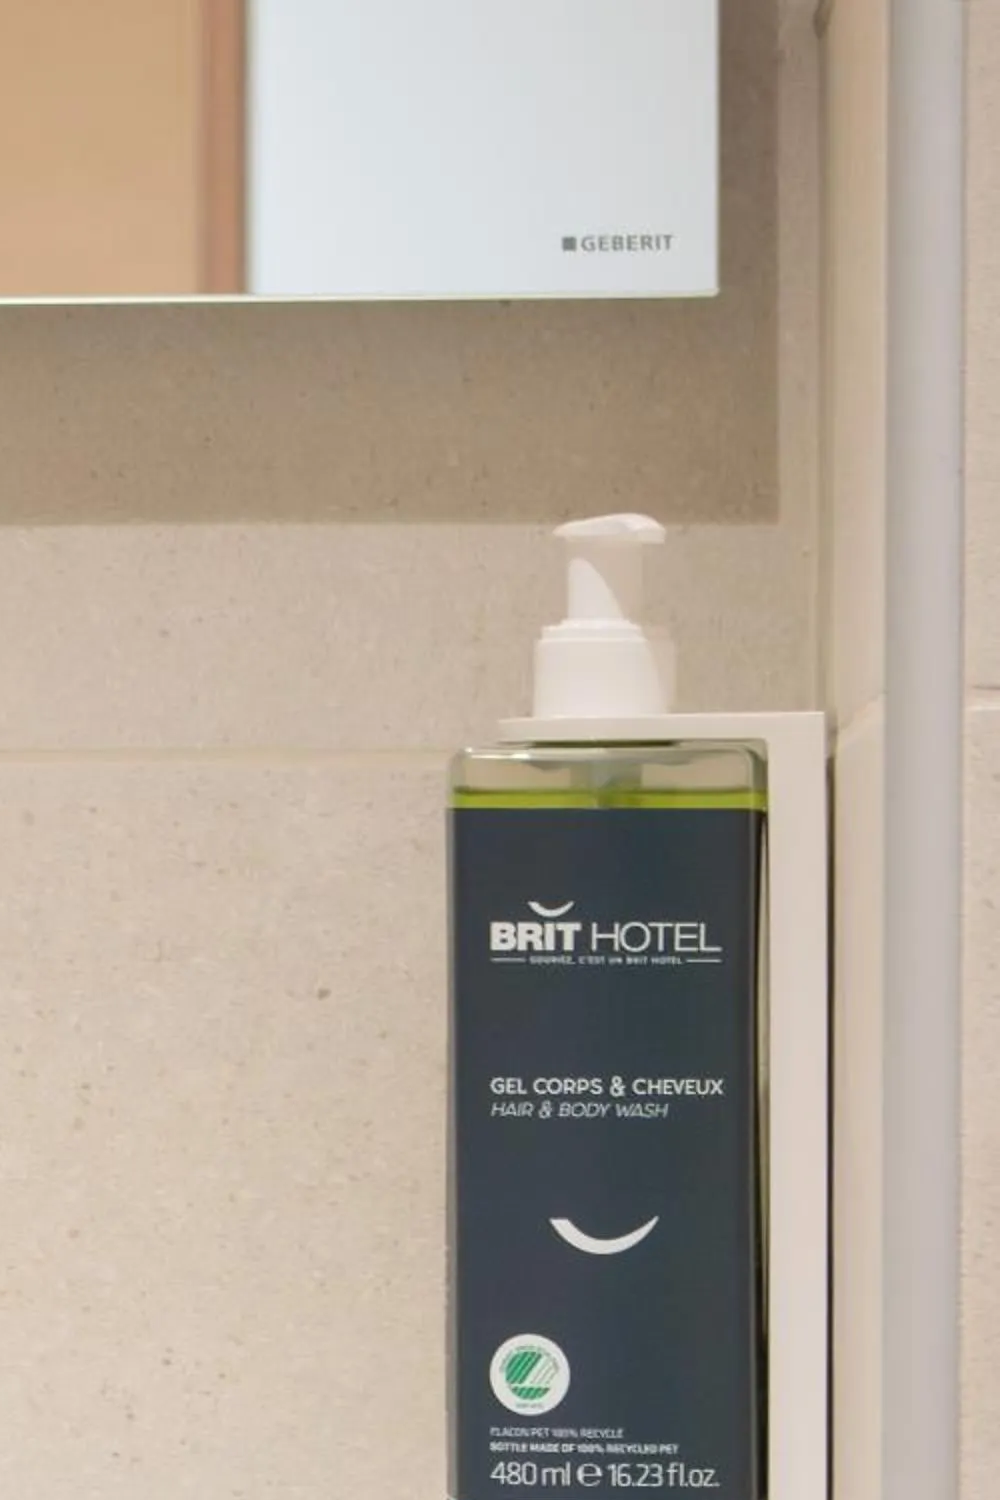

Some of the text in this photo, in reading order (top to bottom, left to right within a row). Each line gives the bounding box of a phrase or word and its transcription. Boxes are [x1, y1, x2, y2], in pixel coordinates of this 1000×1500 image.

[580, 234, 673, 252] GEBERIT
[490, 921, 722, 953] BRIT HOTEL
[490, 1075, 724, 1097] GEL CORPS & CHEVEUX
[490, 1101, 669, 1119] HAIR & BODY WASH
[489, 1442, 528, 1453] BOTTLE
[530, 1443, 559, 1453] MADE
[489, 1461, 537, 1486] 480
[541, 1461, 571, 1486] ml
[607, 1462, 663, 1487] 16.23
